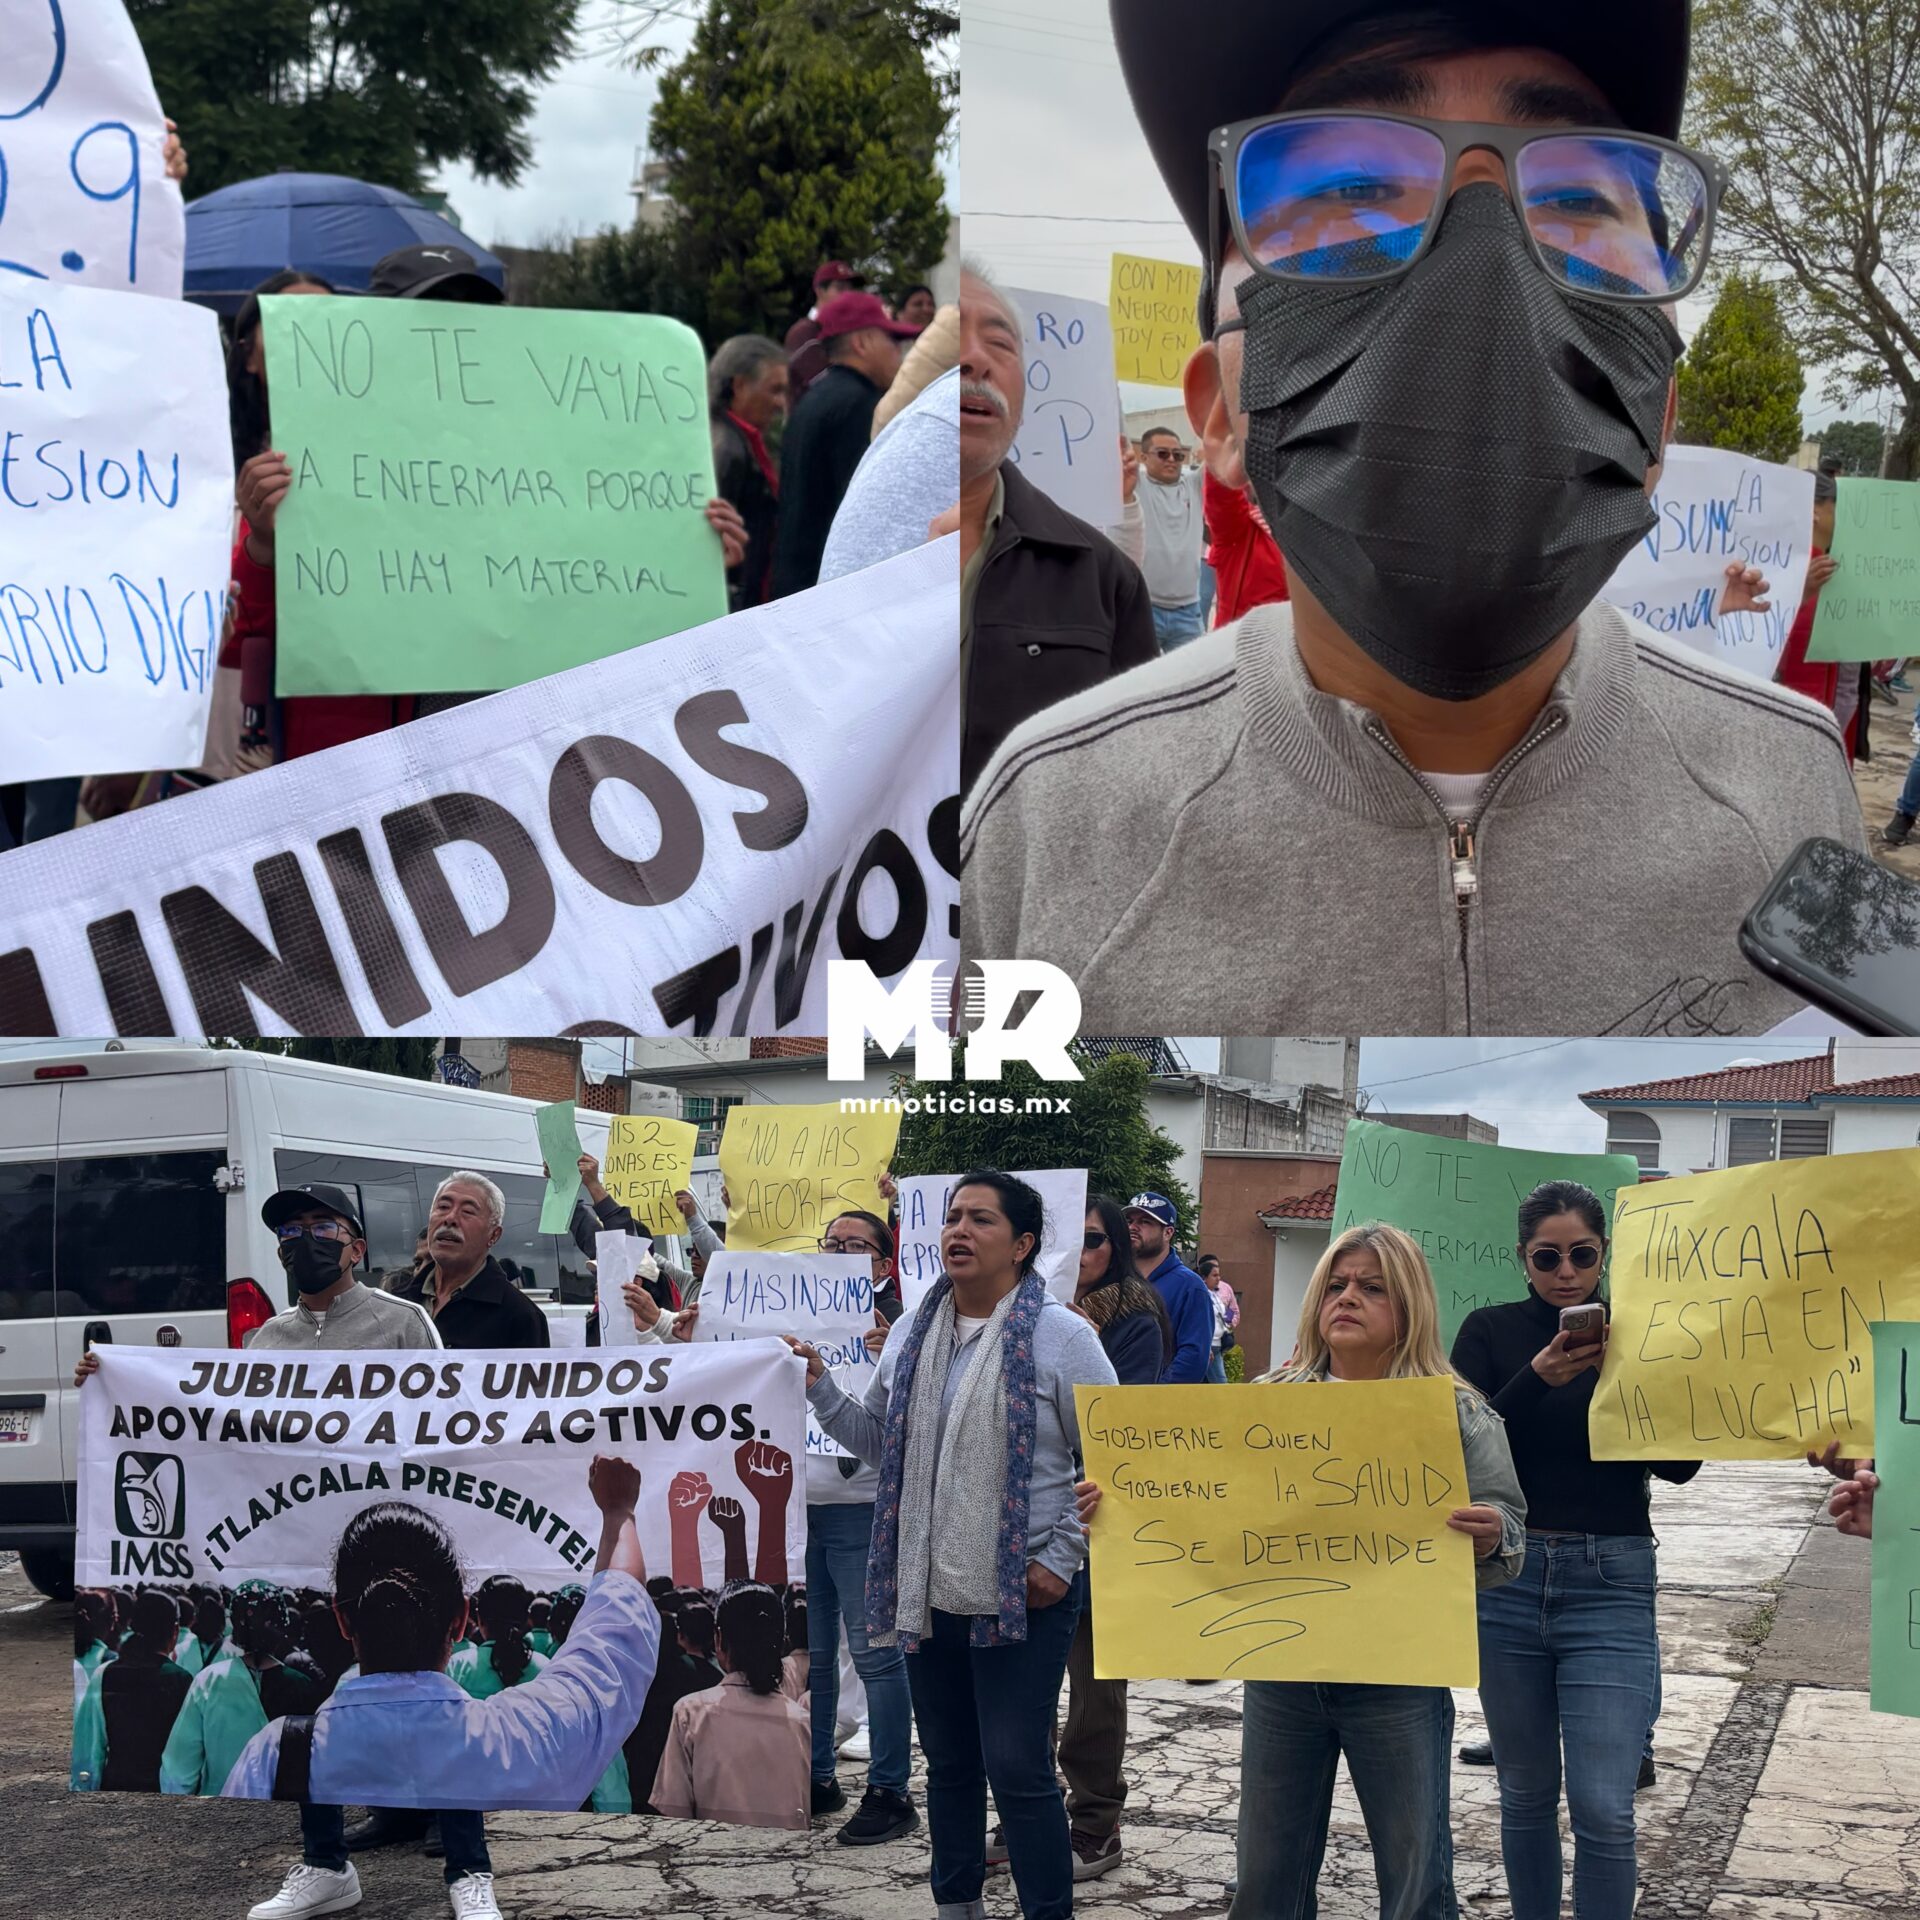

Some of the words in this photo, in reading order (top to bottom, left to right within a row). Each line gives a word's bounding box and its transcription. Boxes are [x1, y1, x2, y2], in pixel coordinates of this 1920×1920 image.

[1118, 262, 1156, 291] CON
[1114, 327, 1152, 352] TOY
[1162, 331, 1187, 351] EN
[291, 318, 374, 399] NO
[410, 328, 495, 406] TE
[525, 345, 697, 424] VAYAS
[298, 447, 324, 489] A
[352, 453, 567, 508] ENFERMAR
[586, 470, 709, 512] PORQUE
[1840, 488, 1869, 529] NO
[1880, 491, 1901, 530] TE
[295, 546, 349, 596] NO
[379, 548, 452, 596] HAY
[484, 554, 688, 597] MATERIAL
[1855, 552, 1918, 578] ENFERMAR
[1824, 598, 1848, 621] NO
[1857, 598, 1881, 619] HAY
[642, 1121, 676, 1147] 2
[788, 1126, 809, 1167] A
[629, 1178, 675, 1200] ESTA
[1353, 1137, 1402, 1188] NO
[1425, 1151, 1478, 1204] TE
[1638, 1295, 1774, 1362] ESTA
[1802, 1280, 1887, 1352] EN
[180, 1360, 464, 1399] JUBILADOS
[480, 1356, 672, 1399] UNIDOS
[110, 1404, 352, 1444] APOYANDO
[364, 1411, 397, 1445] A
[415, 1410, 506, 1446] LOS
[522, 1403, 772, 1445] ACTIVOS.
[1087, 1397, 1223, 1450] GOBIERNE
[1244, 1423, 1332, 1452] QUIEN
[1111, 1462, 1228, 1501] GOBIERNE
[401, 1461, 596, 1574] PRESENTE!
[110, 1540, 194, 1579] IMSS
[1133, 1519, 1215, 1566] SE
[1242, 1529, 1437, 1566] DEFIENDE
